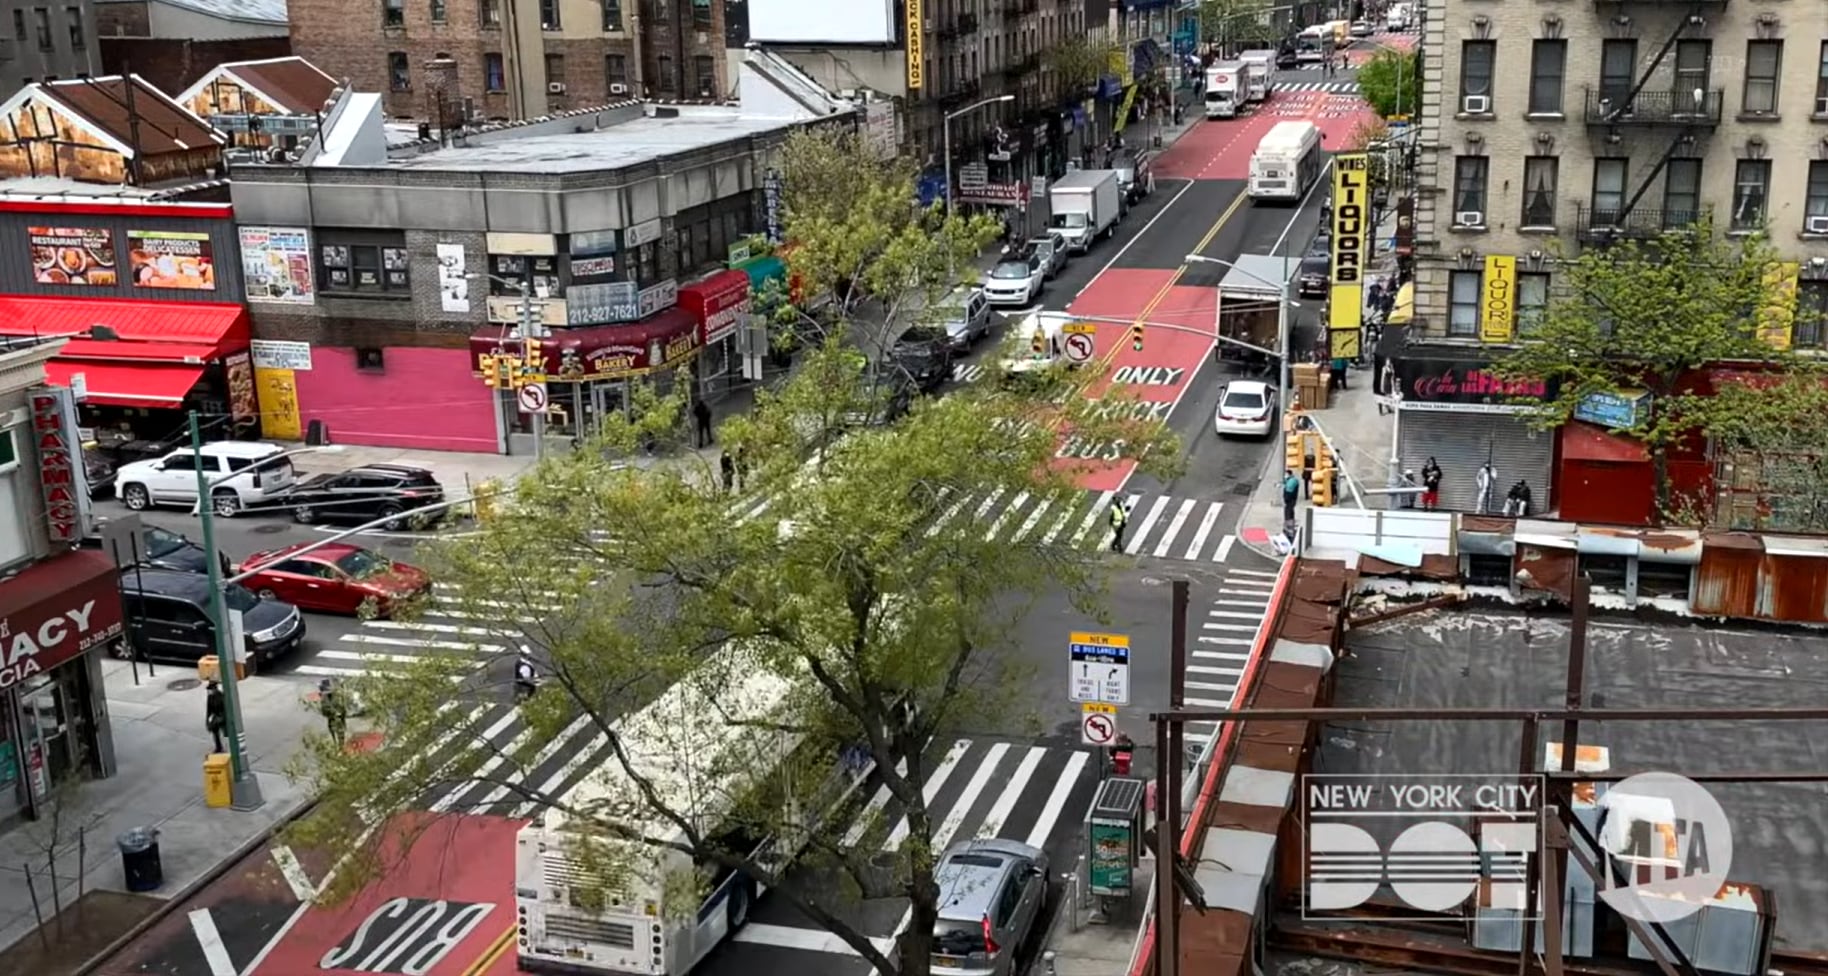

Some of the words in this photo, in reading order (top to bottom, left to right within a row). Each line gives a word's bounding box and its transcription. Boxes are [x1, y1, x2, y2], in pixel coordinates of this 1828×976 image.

[910, 22, 920, 79] CASHING
[1338, 158, 1366, 171] WINES
[1337, 173, 1361, 282] LIQUORS
[31, 236, 82, 247] RESTAURANT
[143, 246, 201, 255] DELICATESSEN
[595, 355, 636, 371] BAKERY
[1111, 366, 1185, 385] ONLY
[1056, 433, 1128, 461] BUS
[33, 396, 72, 540] PHARMACY
[0, 600, 95, 670] ACY
[1090, 636, 1109, 644] NEW
[1089, 705, 1109, 713] NEW
[319, 896, 497, 976] BUS
